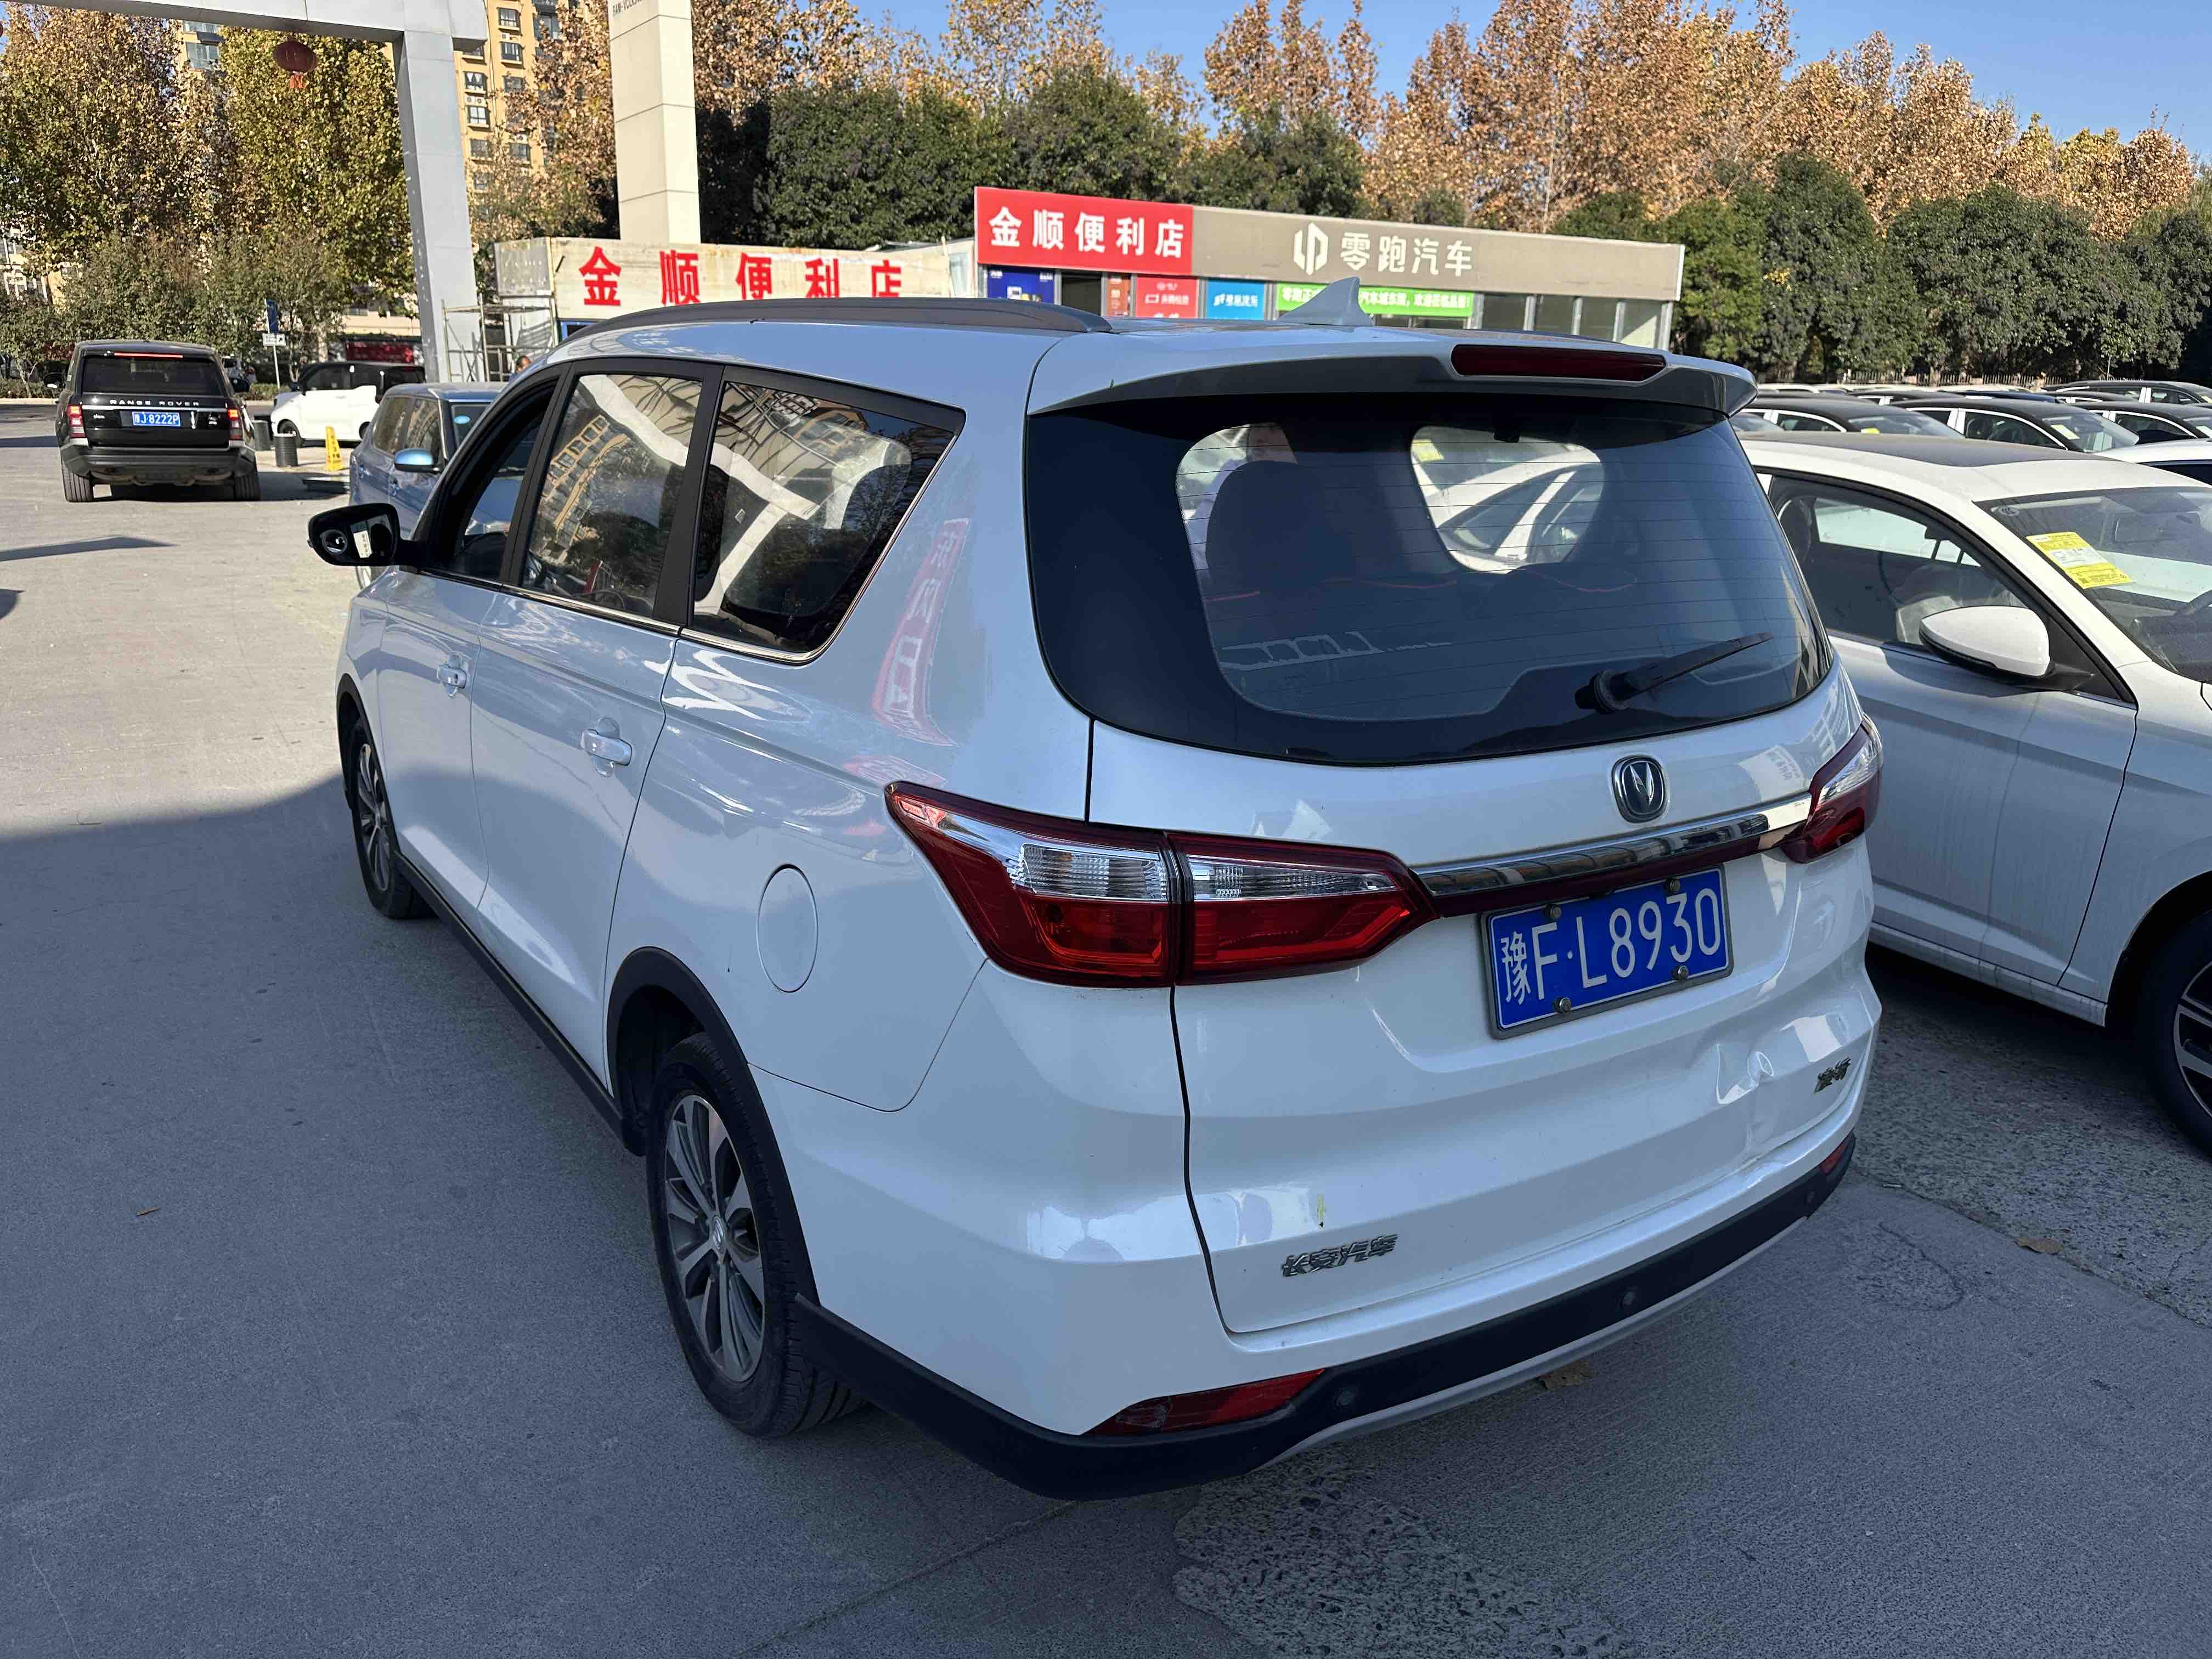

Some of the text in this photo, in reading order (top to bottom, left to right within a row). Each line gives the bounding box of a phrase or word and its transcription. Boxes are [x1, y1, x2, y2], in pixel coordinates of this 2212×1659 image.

[989, 206, 1184, 258] 金顺便利店
[1340, 232, 1472, 276] 零跑汽车
[579, 246, 902, 307] 金顺便利店
[1501, 888, 1721, 1005] 豫F·L8930
[1281, 1234, 1398, 1277] 长安汽车
